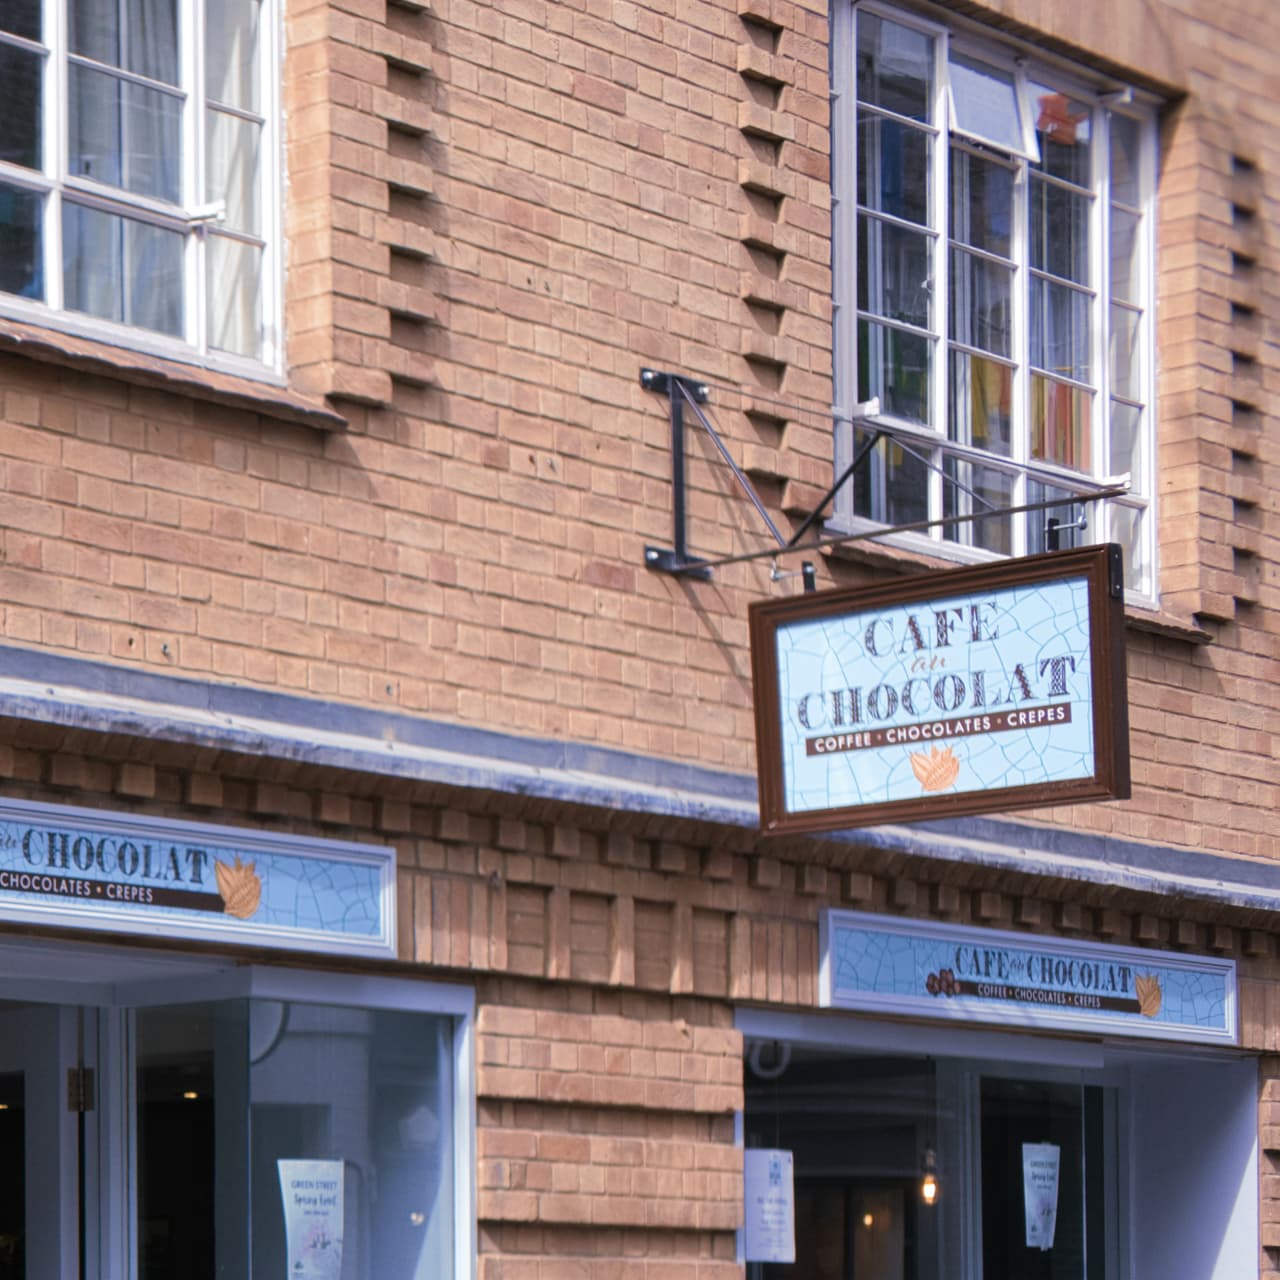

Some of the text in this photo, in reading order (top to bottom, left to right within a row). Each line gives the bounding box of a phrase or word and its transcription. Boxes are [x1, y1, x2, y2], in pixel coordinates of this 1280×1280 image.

[864, 602, 1000, 657] CAFE
[796, 655, 1076, 730] CHOCOLAT
[815, 706, 1066, 753] COFFEE CHOCOLATES CREPES
[21, 828, 208, 885] CHOCOLAT
[0, 873, 92, 897] CHOCOLATES
[106, 884, 154, 903] CREPES
[954, 946, 1010, 979] CAFE
[1026, 954, 1132, 993] CHOCOLAT
[977, 983, 1102, 1009] COFFEE CHOCOLATES CREPES
